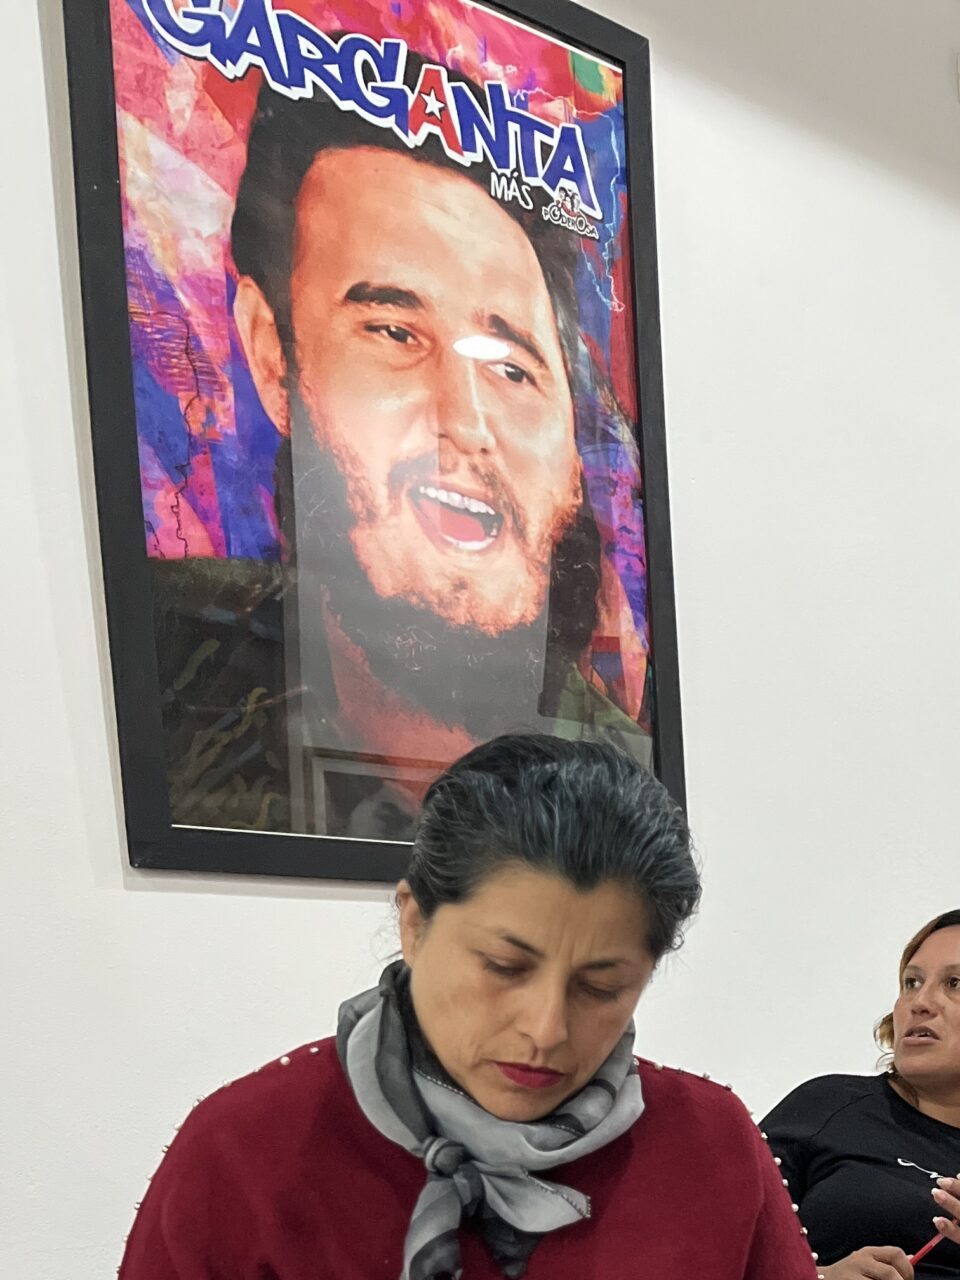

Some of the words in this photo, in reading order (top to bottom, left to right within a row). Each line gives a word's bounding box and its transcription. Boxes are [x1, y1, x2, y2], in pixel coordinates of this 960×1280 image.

[142, 0, 602, 219] GARGANTA
[490, 171, 534, 210] MÁS
[541, 202, 599, 239] PODEROSA
